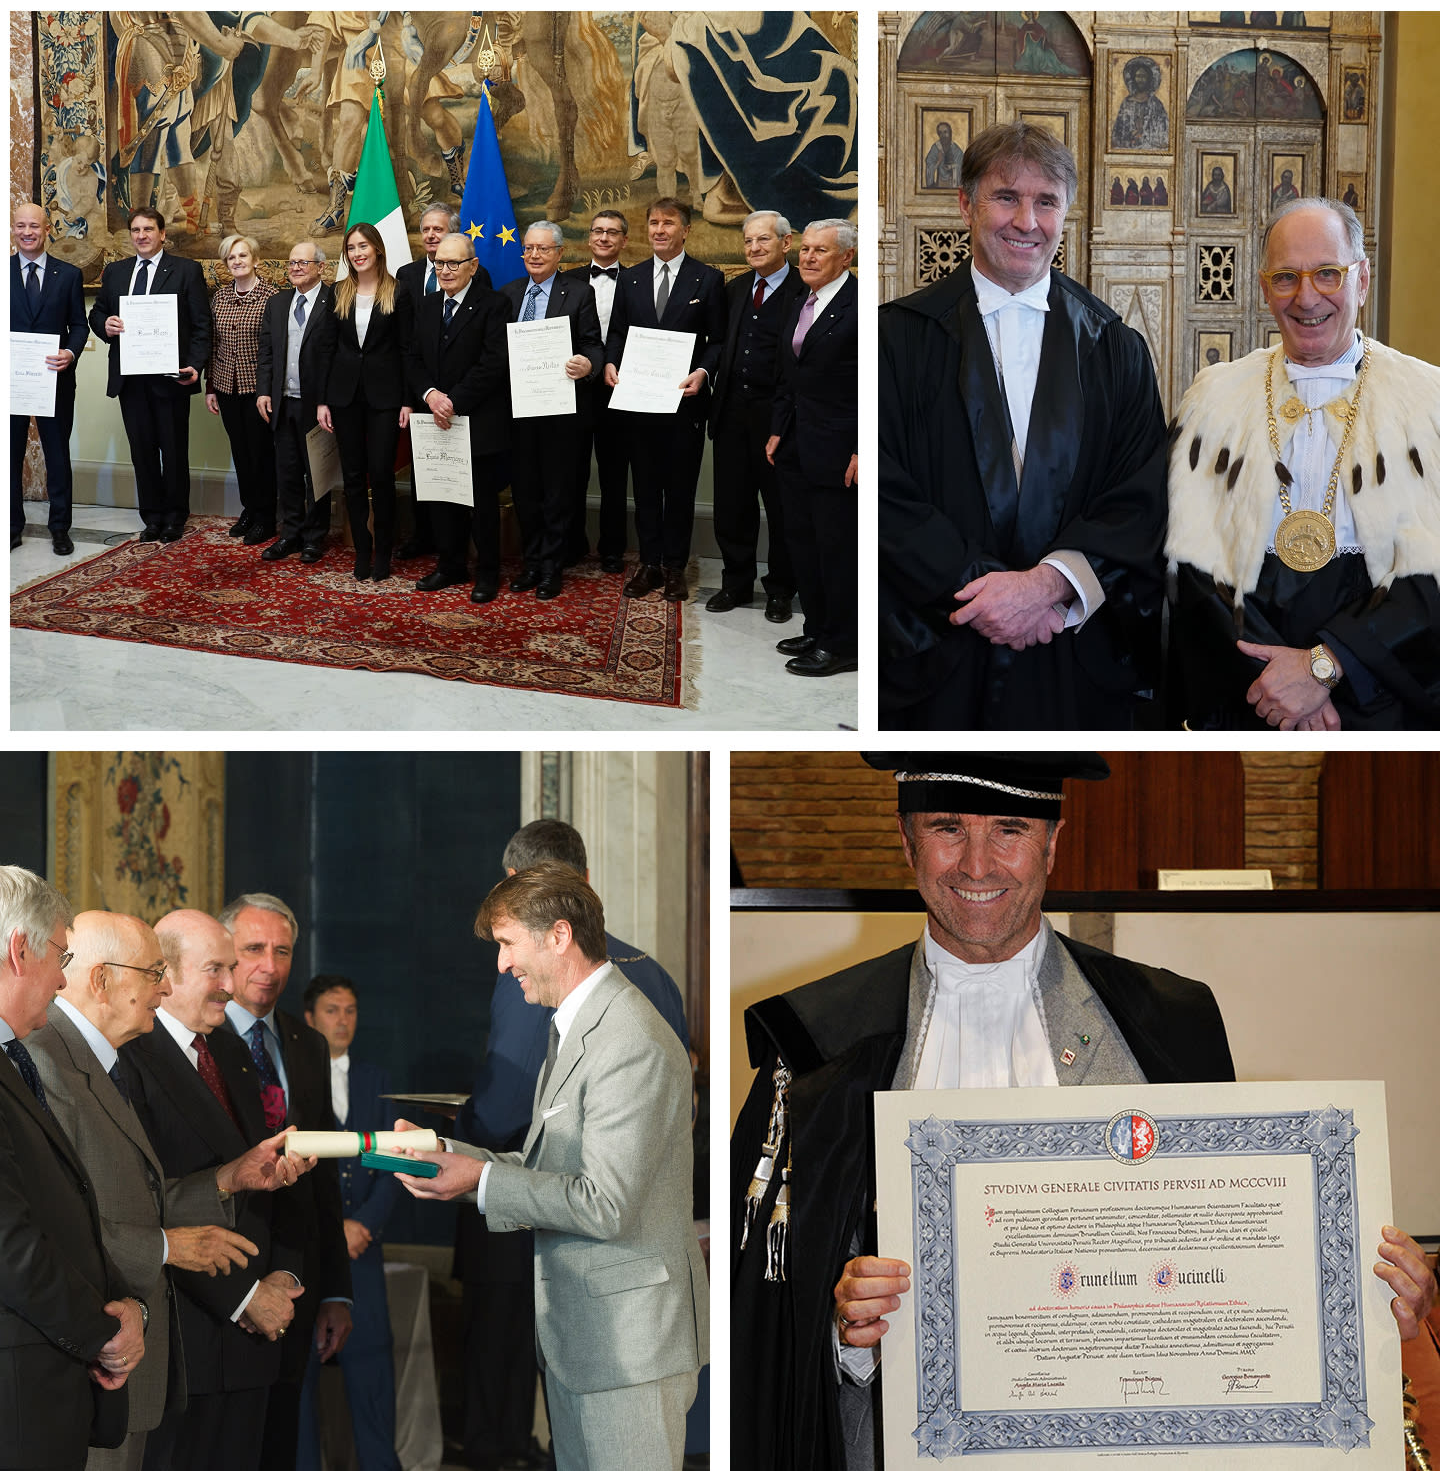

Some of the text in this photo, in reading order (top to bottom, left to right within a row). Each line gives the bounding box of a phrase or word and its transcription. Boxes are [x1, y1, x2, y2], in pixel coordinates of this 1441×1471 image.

[1041, 1182, 1100, 1194] GENERALE
[1103, 1180, 1159, 1192] CIVITATIS
[1209, 1178, 1226, 1189] AD
[1229, 1177, 1287, 1189] MCCCVIII
